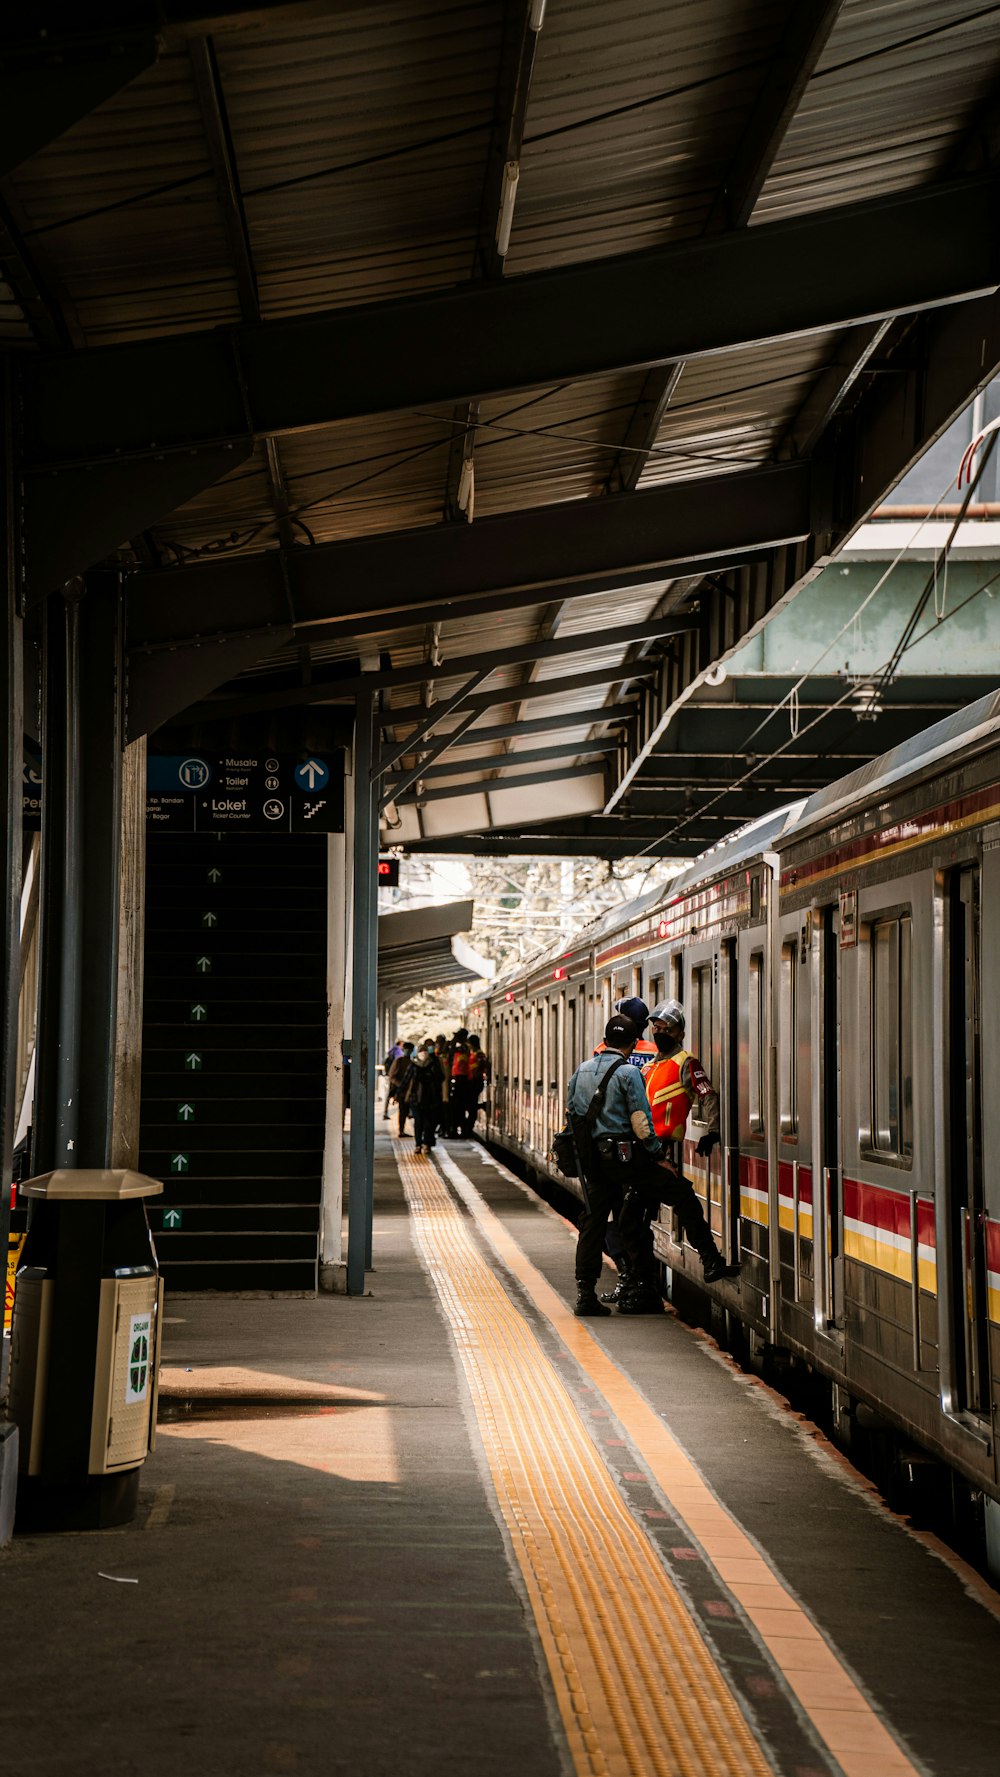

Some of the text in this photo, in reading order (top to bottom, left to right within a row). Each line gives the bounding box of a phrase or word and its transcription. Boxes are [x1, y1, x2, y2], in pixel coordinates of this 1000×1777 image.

[225, 758, 258, 767] Musala
[225, 777, 249, 786] Toilet
[211, 799, 247, 811] Loket
